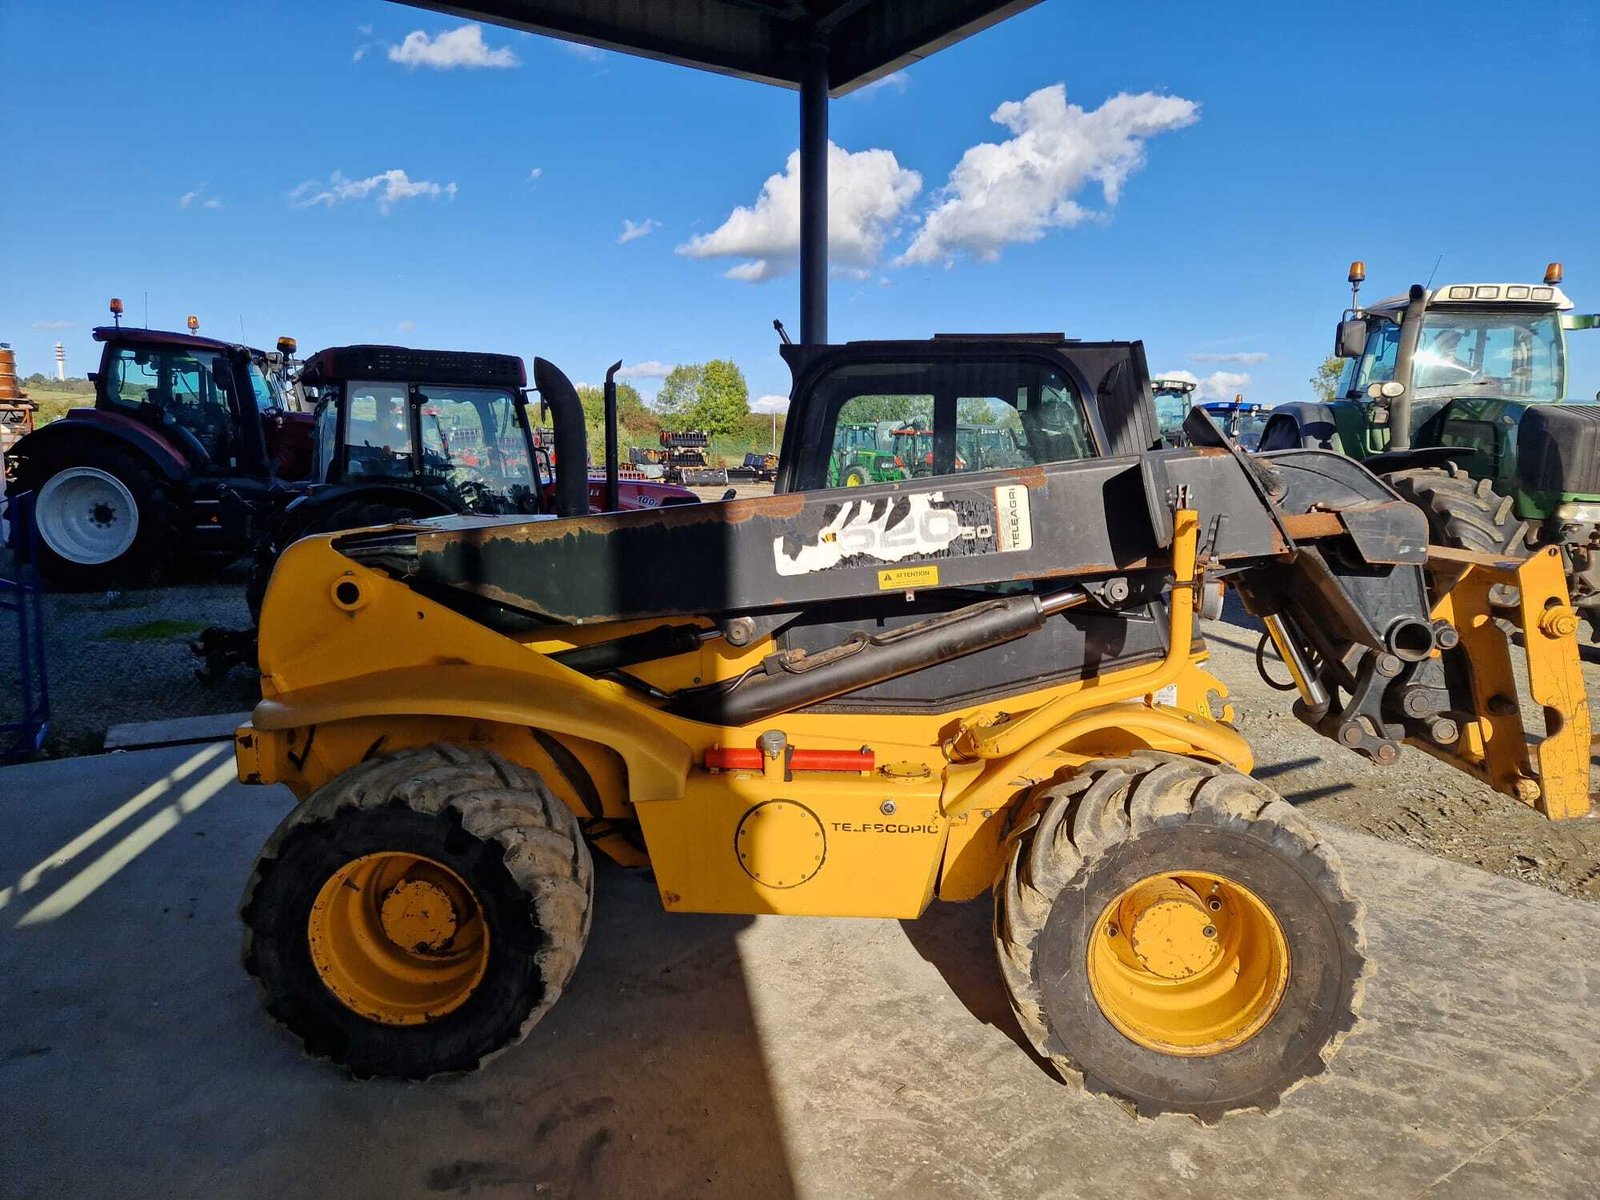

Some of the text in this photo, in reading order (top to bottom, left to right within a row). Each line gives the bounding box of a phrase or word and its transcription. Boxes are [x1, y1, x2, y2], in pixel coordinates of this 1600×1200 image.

[1008, 487, 1020, 549] TELEAGRI
[896, 570, 930, 578] ATTENTION
[831, 822, 939, 834] TEESCOPIC
